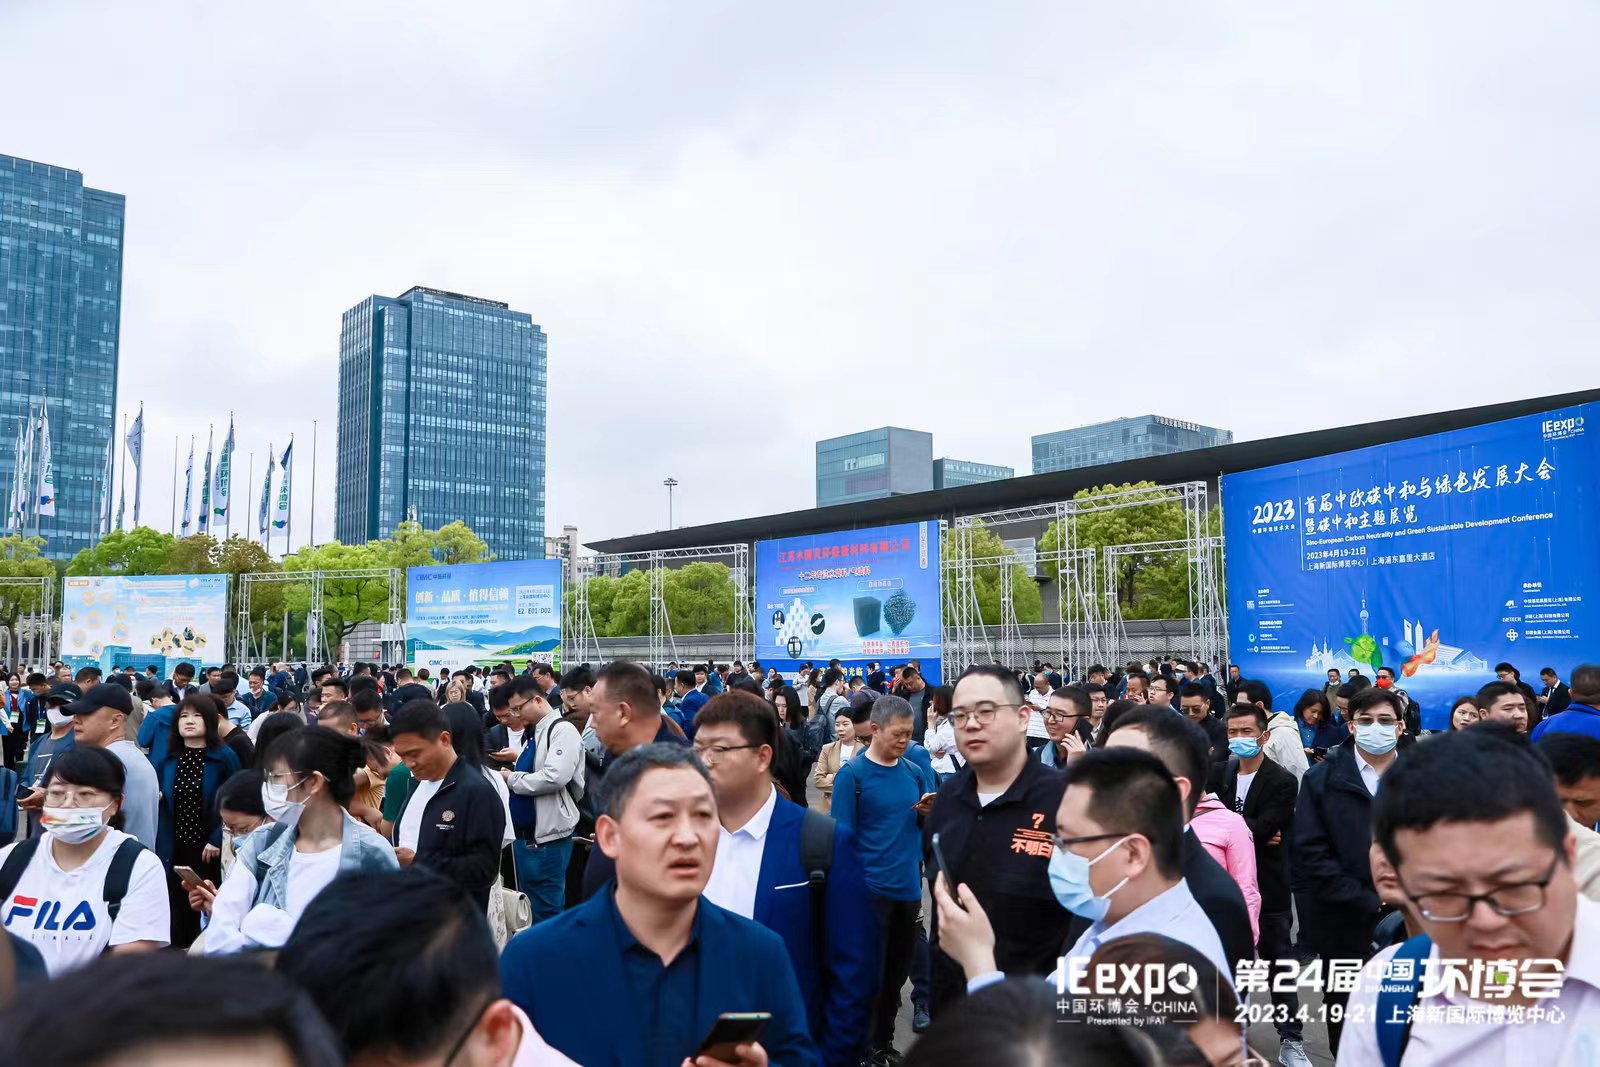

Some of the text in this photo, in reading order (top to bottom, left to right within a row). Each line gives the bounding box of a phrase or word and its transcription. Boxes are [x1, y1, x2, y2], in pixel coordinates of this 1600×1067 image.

[1252, 499, 1296, 525] 2023
[1305, 504, 1418, 535] 暨碳中和主题展览
[1306, 537, 1344, 547] Sino-European
[1366, 531, 1394, 541] Neutrality
[1395, 529, 1406, 537] and
[1407, 527, 1425, 535] Green
[1427, 522, 1464, 533] Sustainable
[1465, 516, 1510, 529] Development
[1511, 511, 1554, 523] Conference
[1306, 546, 1366, 560] 2023年4月19-21日
[1307, 559, 1365, 571] 上海新国际博览中心
[1010, 838, 1054, 858] 不明白
[4, 895, 96, 931] FILA
